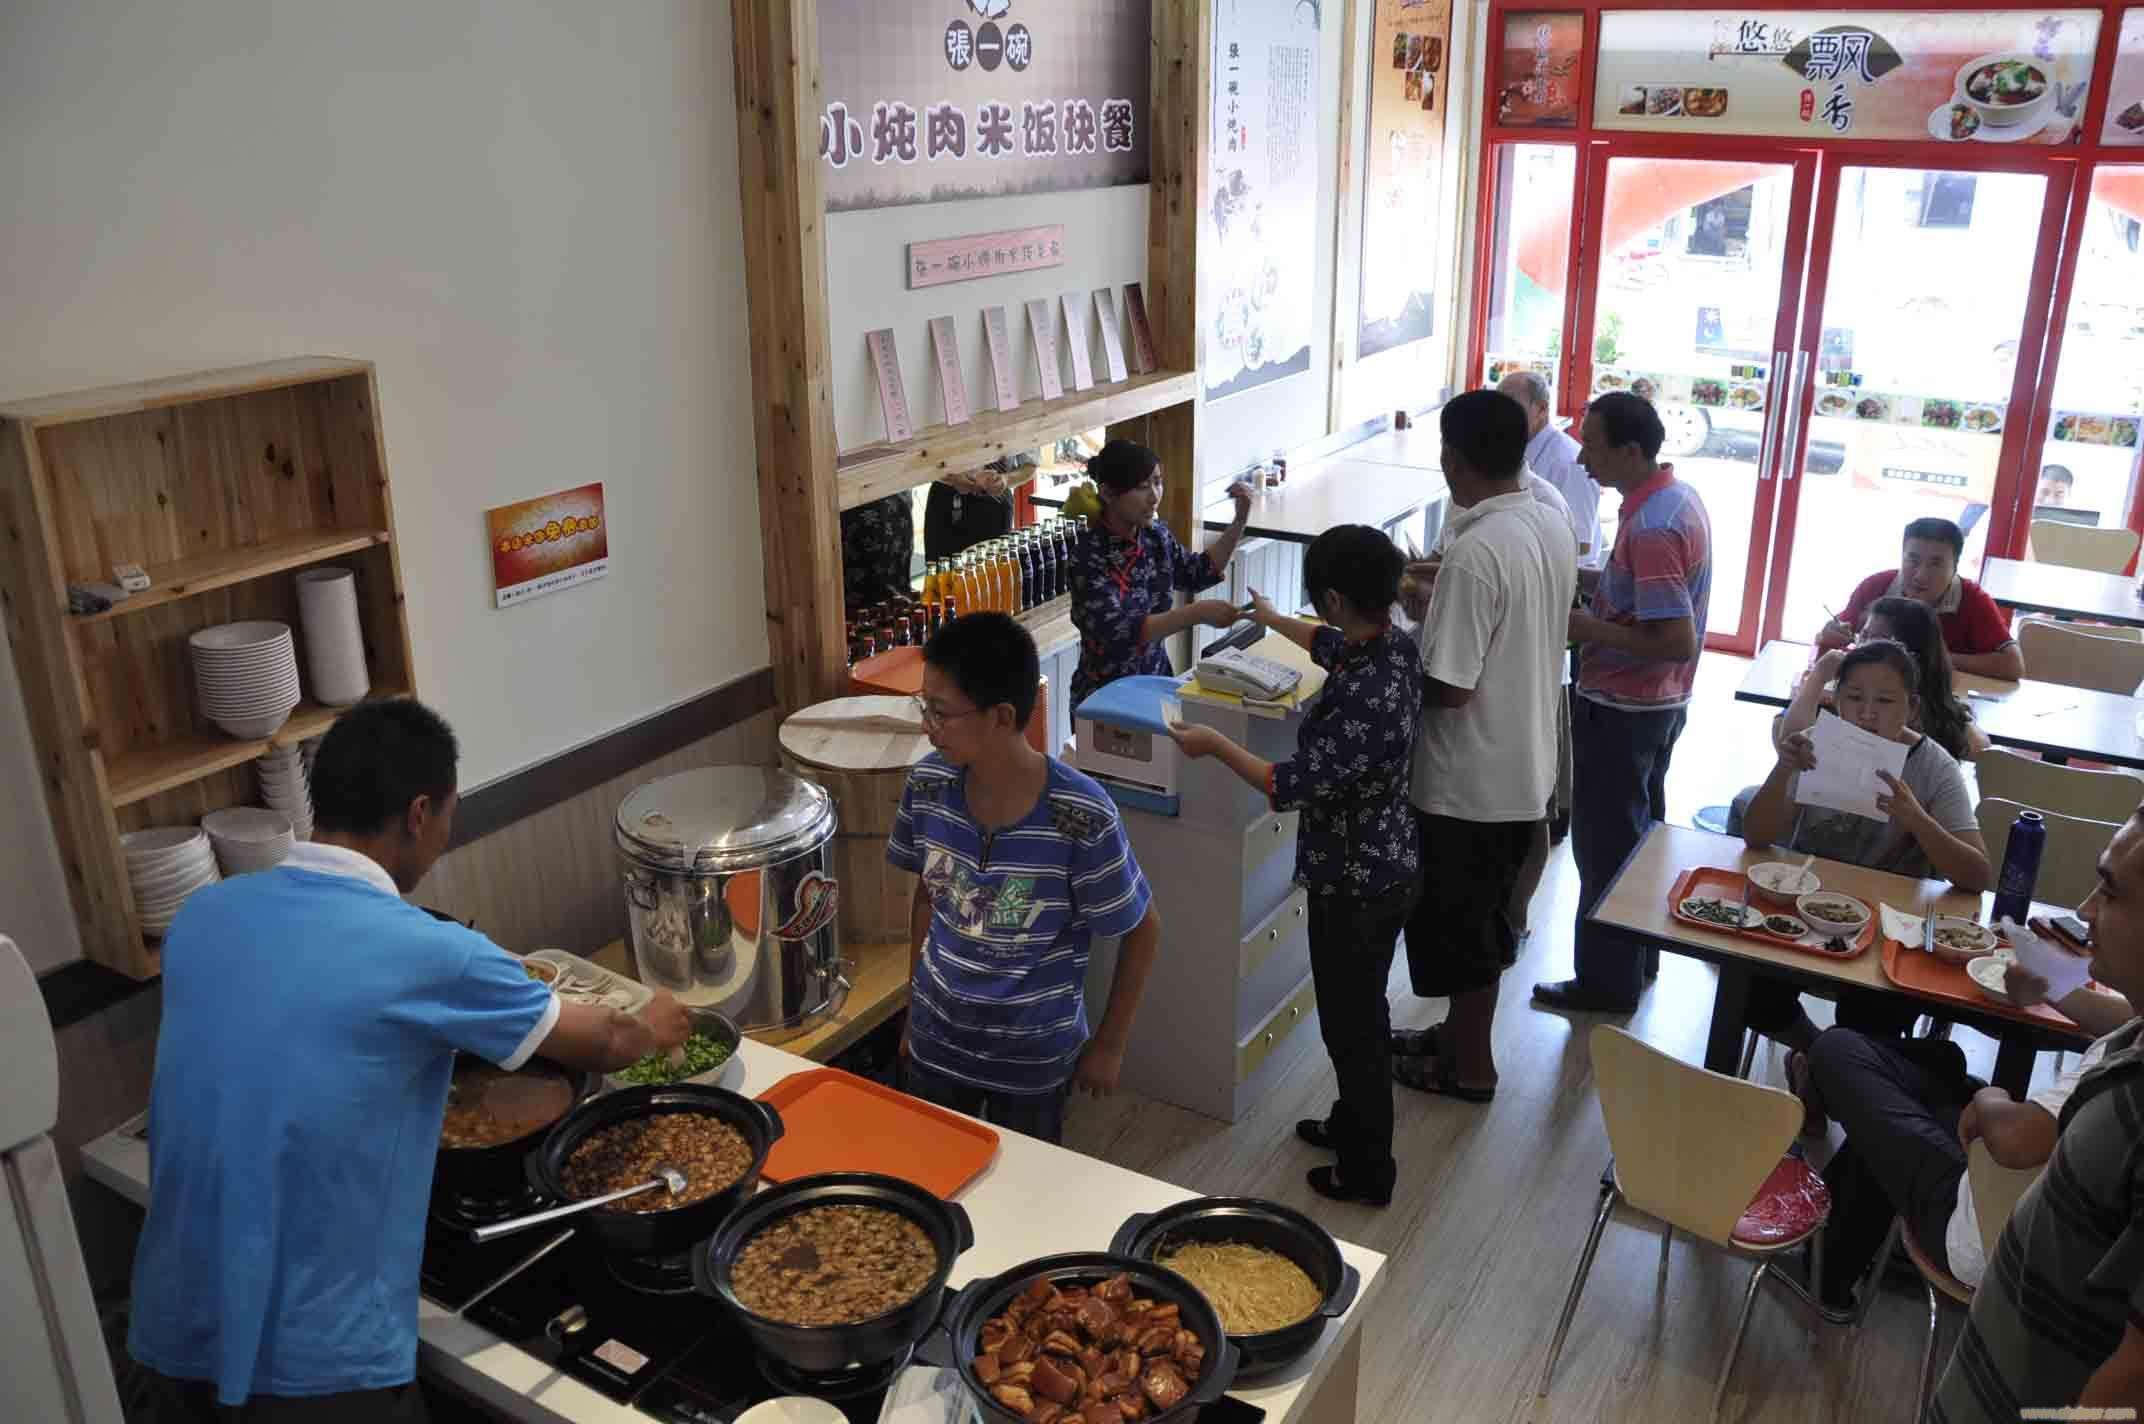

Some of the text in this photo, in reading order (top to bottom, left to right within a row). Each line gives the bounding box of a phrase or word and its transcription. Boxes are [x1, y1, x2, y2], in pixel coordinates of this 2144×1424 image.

[946, 26, 1030, 67] 張一碗
[819, 101, 1135, 167] 小炖肉米饭快餐
